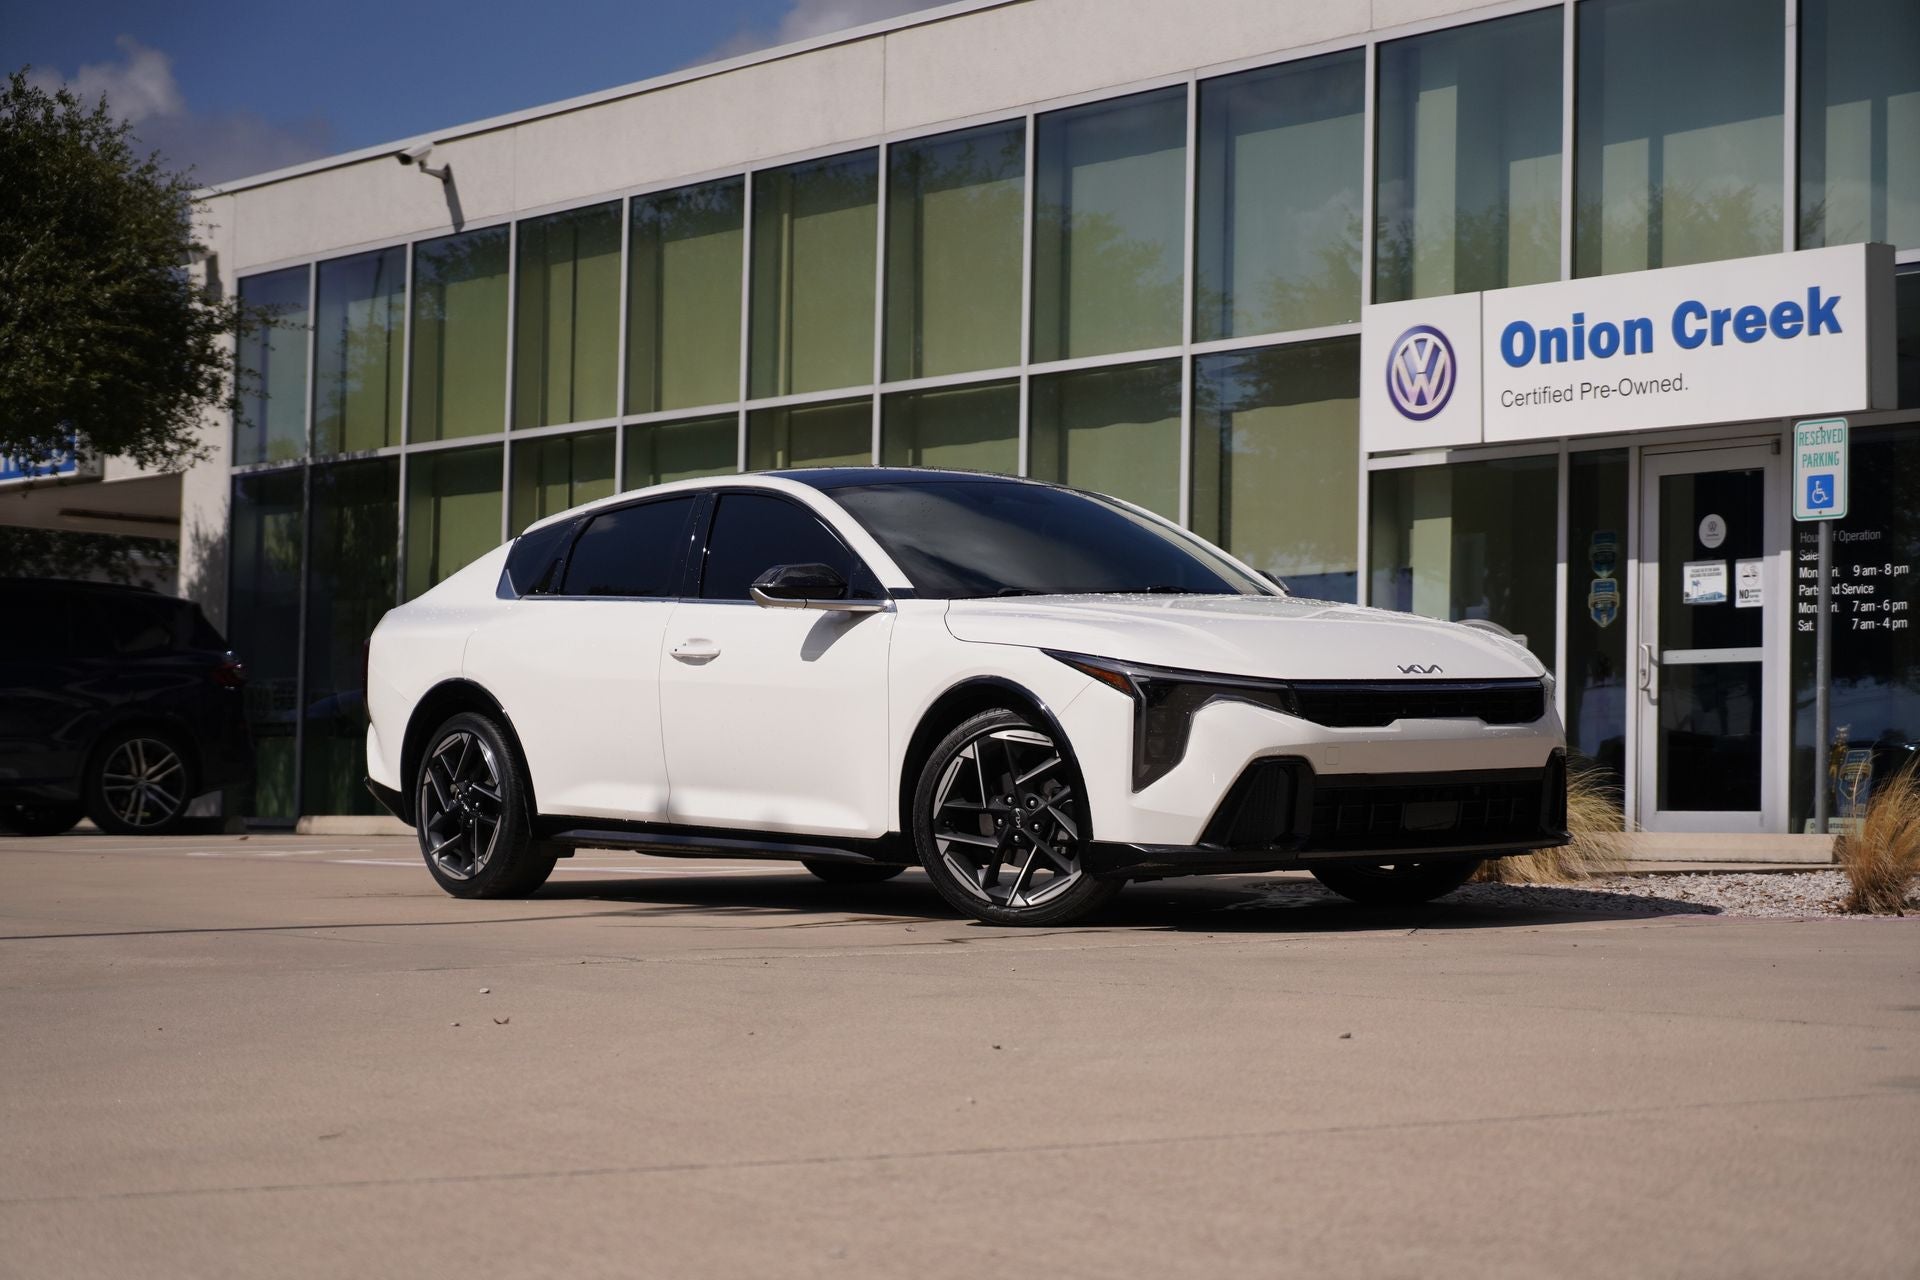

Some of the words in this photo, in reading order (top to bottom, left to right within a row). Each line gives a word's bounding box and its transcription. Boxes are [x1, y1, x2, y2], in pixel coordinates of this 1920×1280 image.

[1500, 312, 1653, 368] Onion
[1671, 286, 1843, 350] Creek
[1393, 331, 1452, 414] VW
[1501, 383, 1573, 408] Certified
[1581, 373, 1689, 401] Pre-Owned.
[1798, 428, 1843, 447] RESERVED
[1802, 451, 1840, 468] PARKING
[1800, 531, 1819, 543] Hou
[1838, 529, 1881, 543] Operation
[1831, 565, 1840, 577] ri.
[1853, 564, 1860, 577] 9
[1862, 567, 1877, 577] am
[1884, 563, 1891, 575] 8
[1893, 565, 1909, 577] pm
[1739, 589, 1750, 599] NO
[1841, 583, 1874, 595] Service
[1831, 601, 1840, 613] ri.
[1852, 600, 1859, 612] 7
[1860, 602, 1875, 612] am
[1883, 599, 1890, 611] 6
[1892, 601, 1908, 613] pm
[1798, 619, 1814, 631] Sat.
[1852, 618, 1858, 630] 7
[1860, 620, 1875, 630] am
[1882, 617, 1890, 629] 4
[1892, 619, 1908, 631] pm
[1397, 664, 1444, 674] KIA
